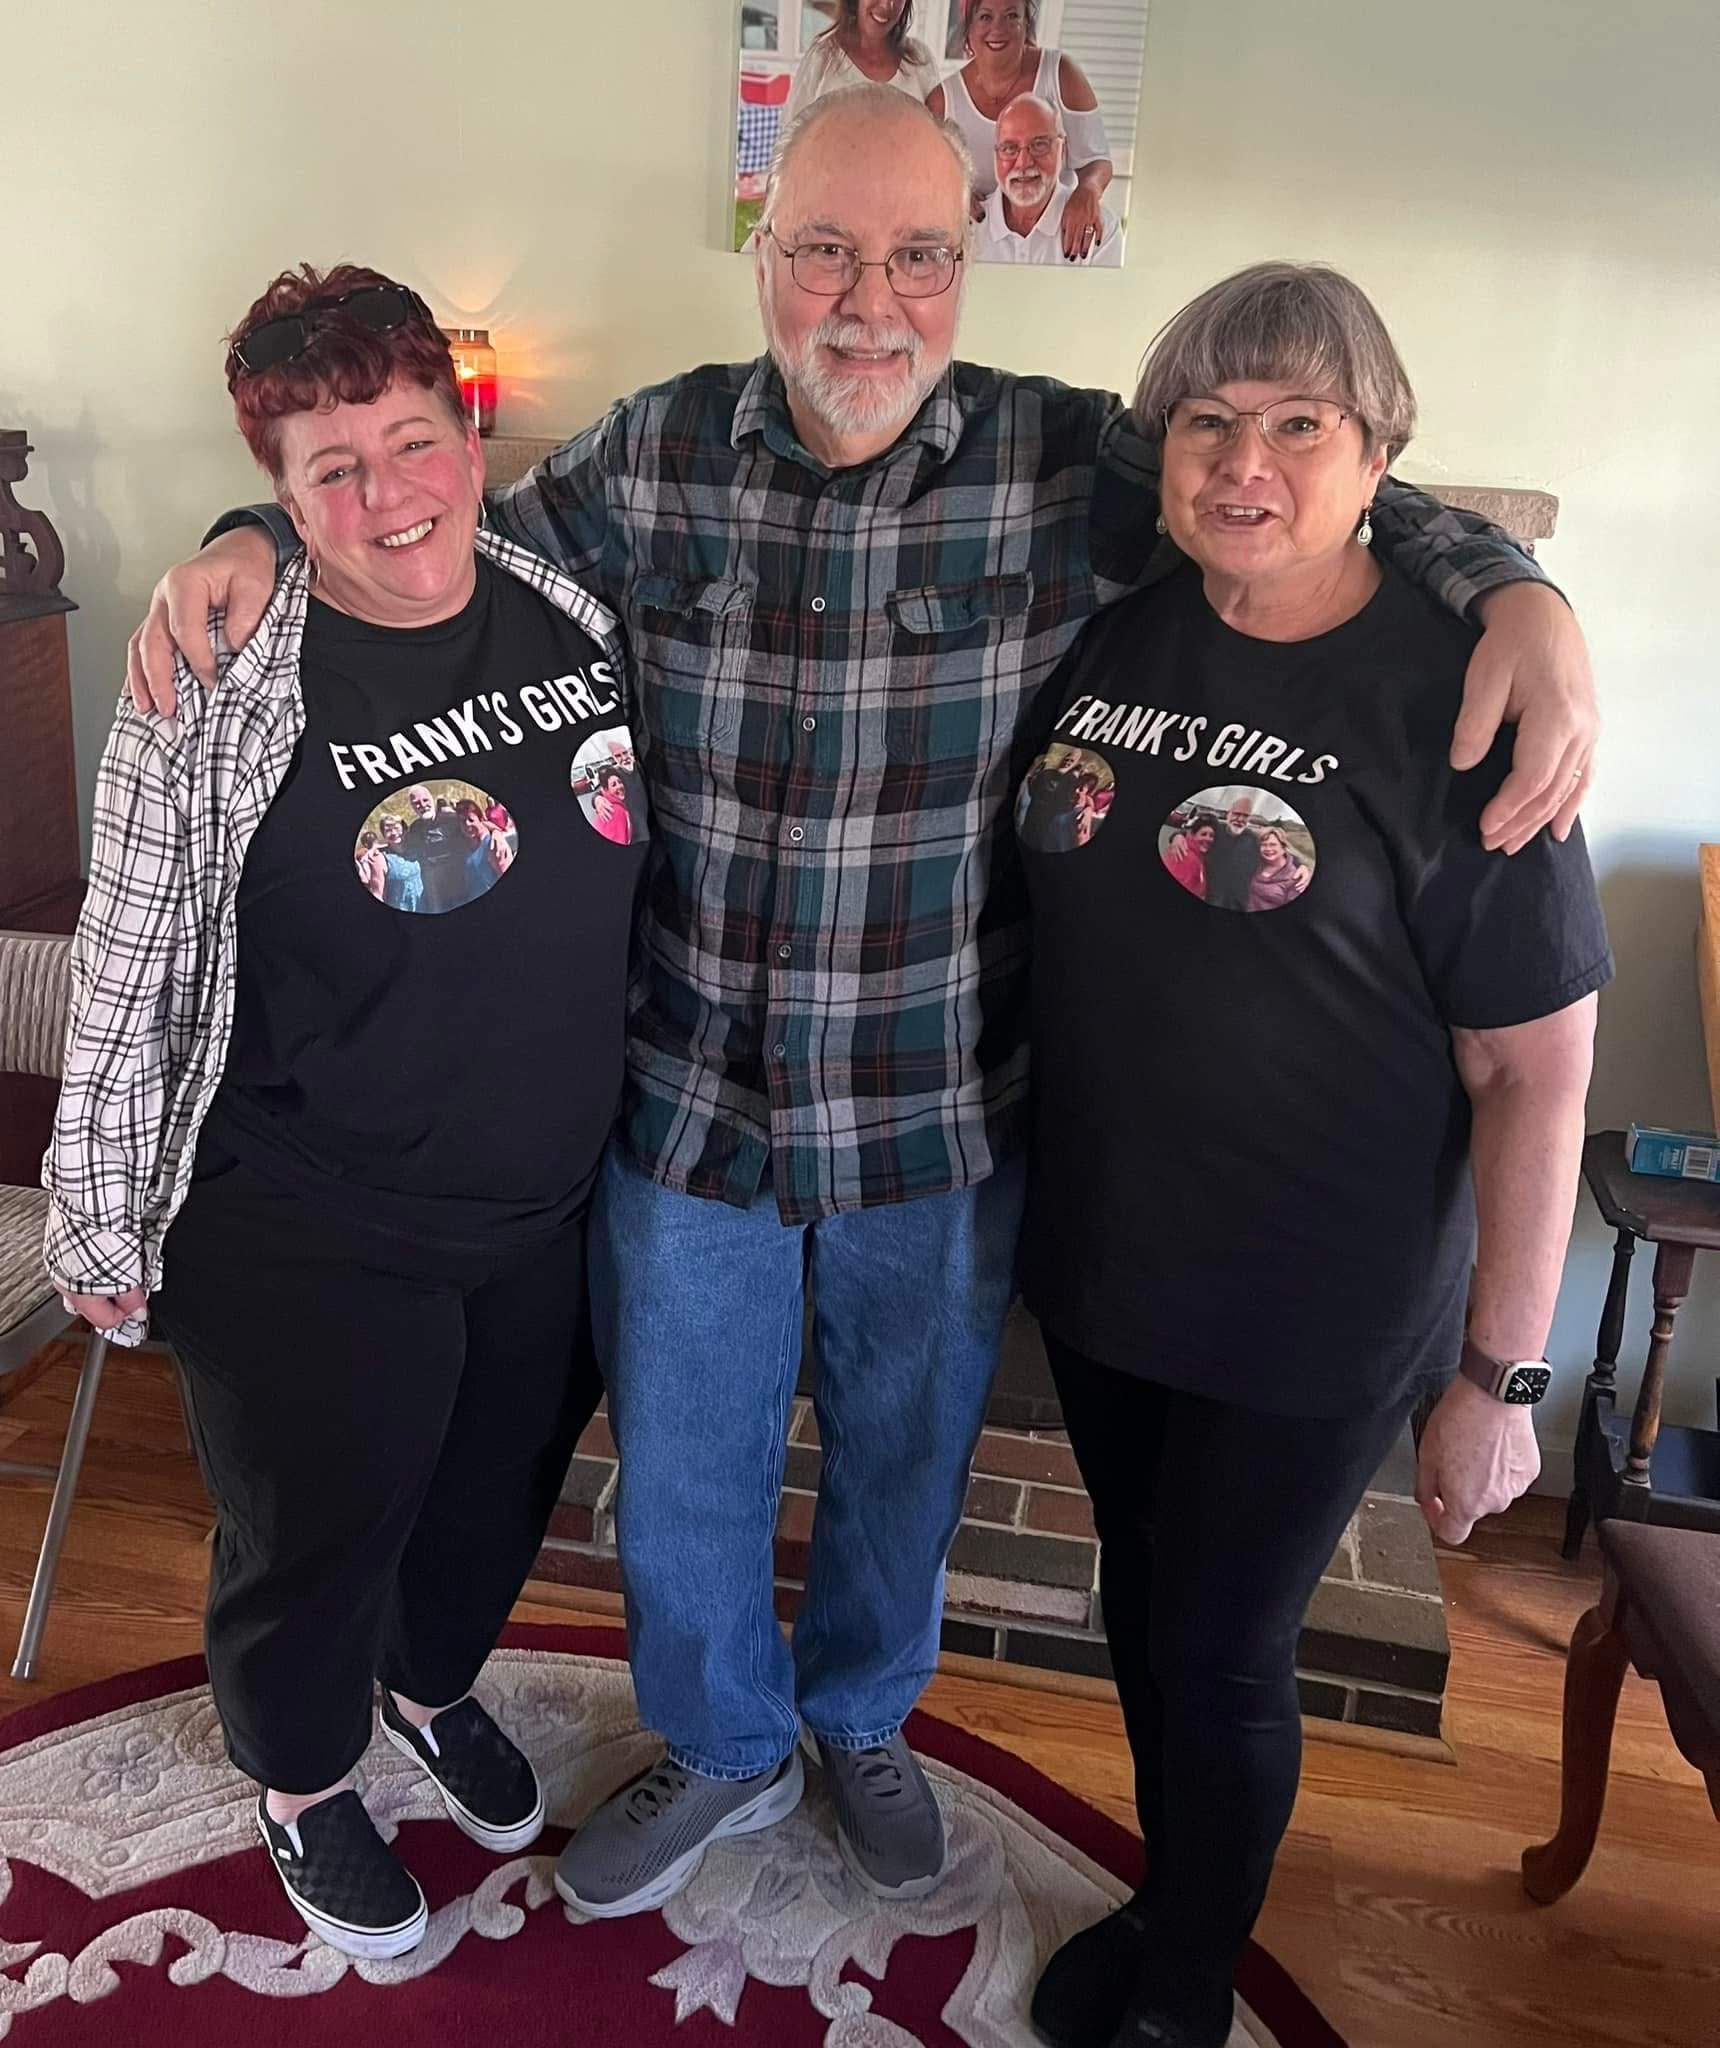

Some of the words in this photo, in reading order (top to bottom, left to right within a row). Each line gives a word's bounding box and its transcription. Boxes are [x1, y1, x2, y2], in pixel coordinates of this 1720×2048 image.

[328, 691, 524, 790] FRANK'S
[519, 661, 621, 732] GIRLS
[1054, 695, 1208, 762] FRANK'S
[1206, 723, 1339, 784] GIRLS
